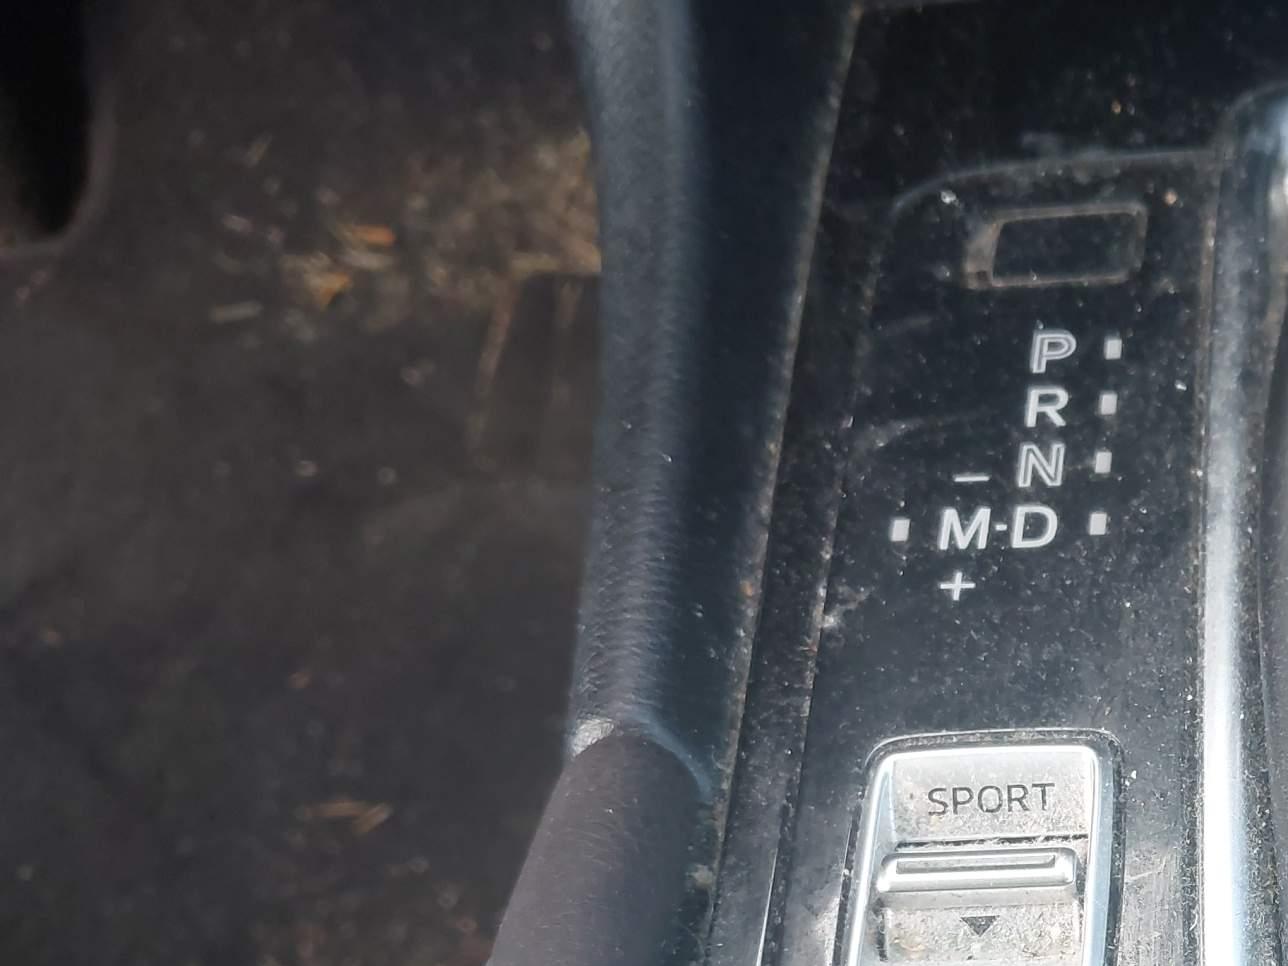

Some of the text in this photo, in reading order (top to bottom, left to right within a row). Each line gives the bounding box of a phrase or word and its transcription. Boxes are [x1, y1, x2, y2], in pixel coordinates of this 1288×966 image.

[1030, 329, 1077, 374] P
[1024, 385, 1070, 428] R
[1017, 443, 1067, 488] N
[928, 783, 1056, 816] SPORT
